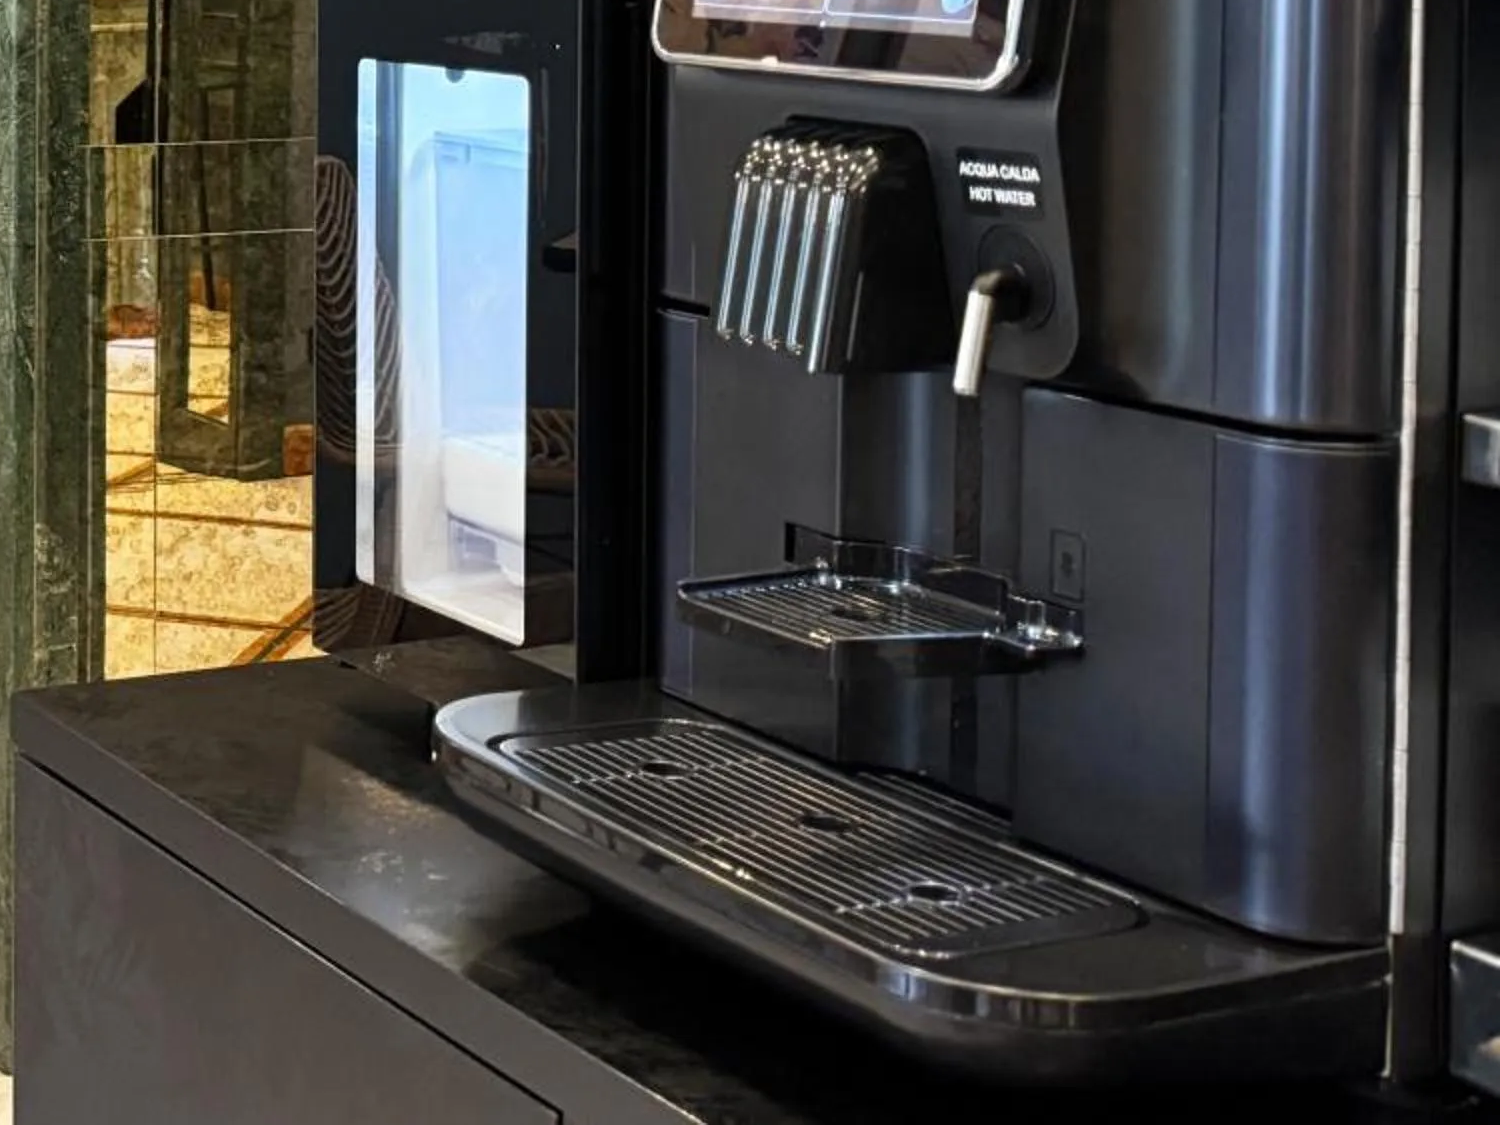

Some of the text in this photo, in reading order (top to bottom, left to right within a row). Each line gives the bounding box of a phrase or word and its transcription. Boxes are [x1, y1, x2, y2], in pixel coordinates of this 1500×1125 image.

[959, 160, 1040, 183] ACQUA CALDA
[969, 185, 1036, 207] HOT WATER
